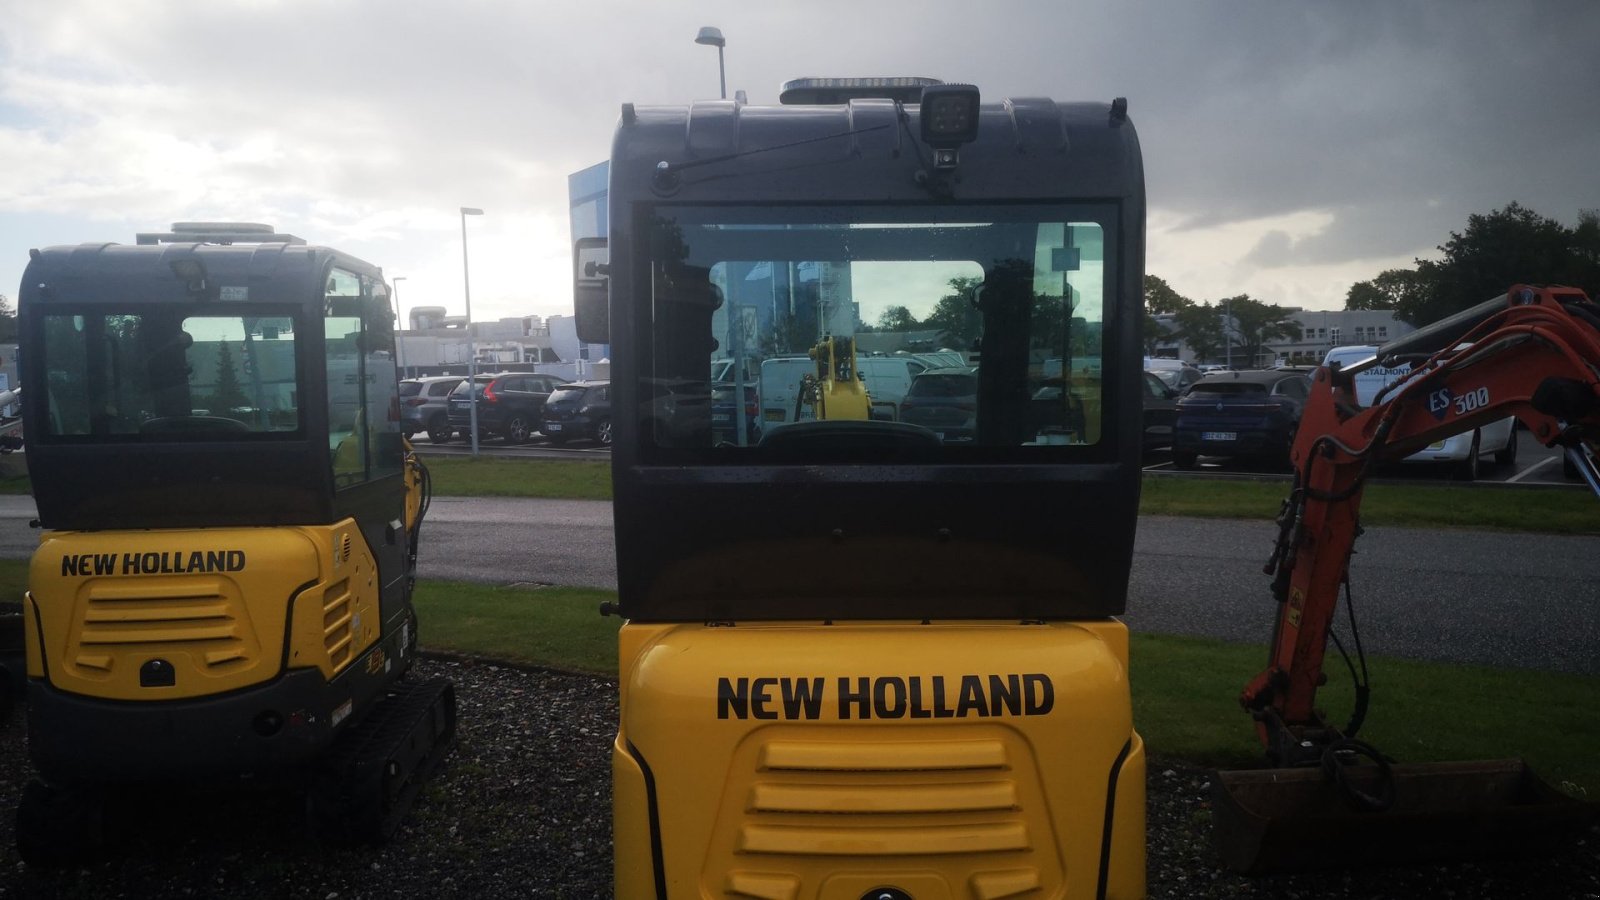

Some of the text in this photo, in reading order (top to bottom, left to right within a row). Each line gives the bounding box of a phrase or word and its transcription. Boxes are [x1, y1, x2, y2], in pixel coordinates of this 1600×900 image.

[1429, 386, 1489, 415] ES 300
[62, 551, 245, 576] NEW HOLLAND
[717, 673, 1055, 719] NEW HOLLAND
